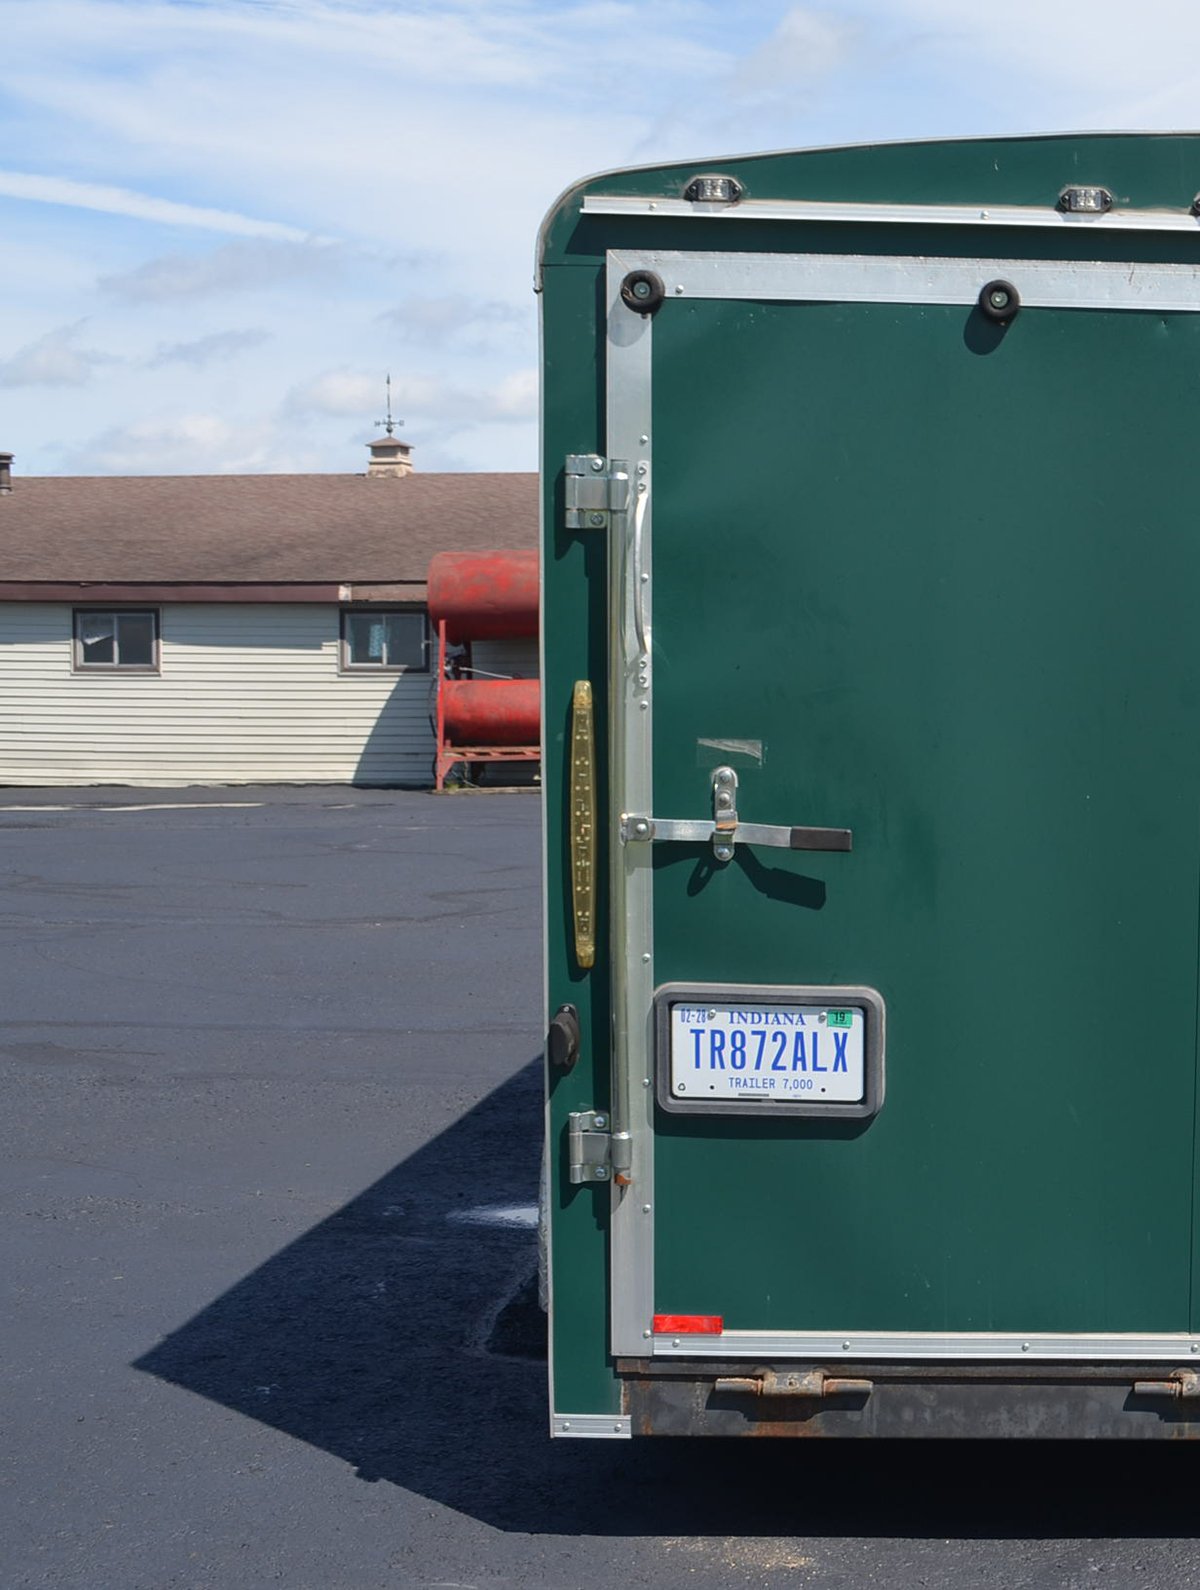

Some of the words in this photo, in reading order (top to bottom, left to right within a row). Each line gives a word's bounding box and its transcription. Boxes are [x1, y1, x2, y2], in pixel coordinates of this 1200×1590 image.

[729, 1011, 807, 1026] INDIANA
[834, 1011, 845, 1022] 19
[690, 1029, 849, 1073] TR872ALX
[728, 1077, 776, 1089] TRAILER
[783, 1078, 813, 1090] 7,000
